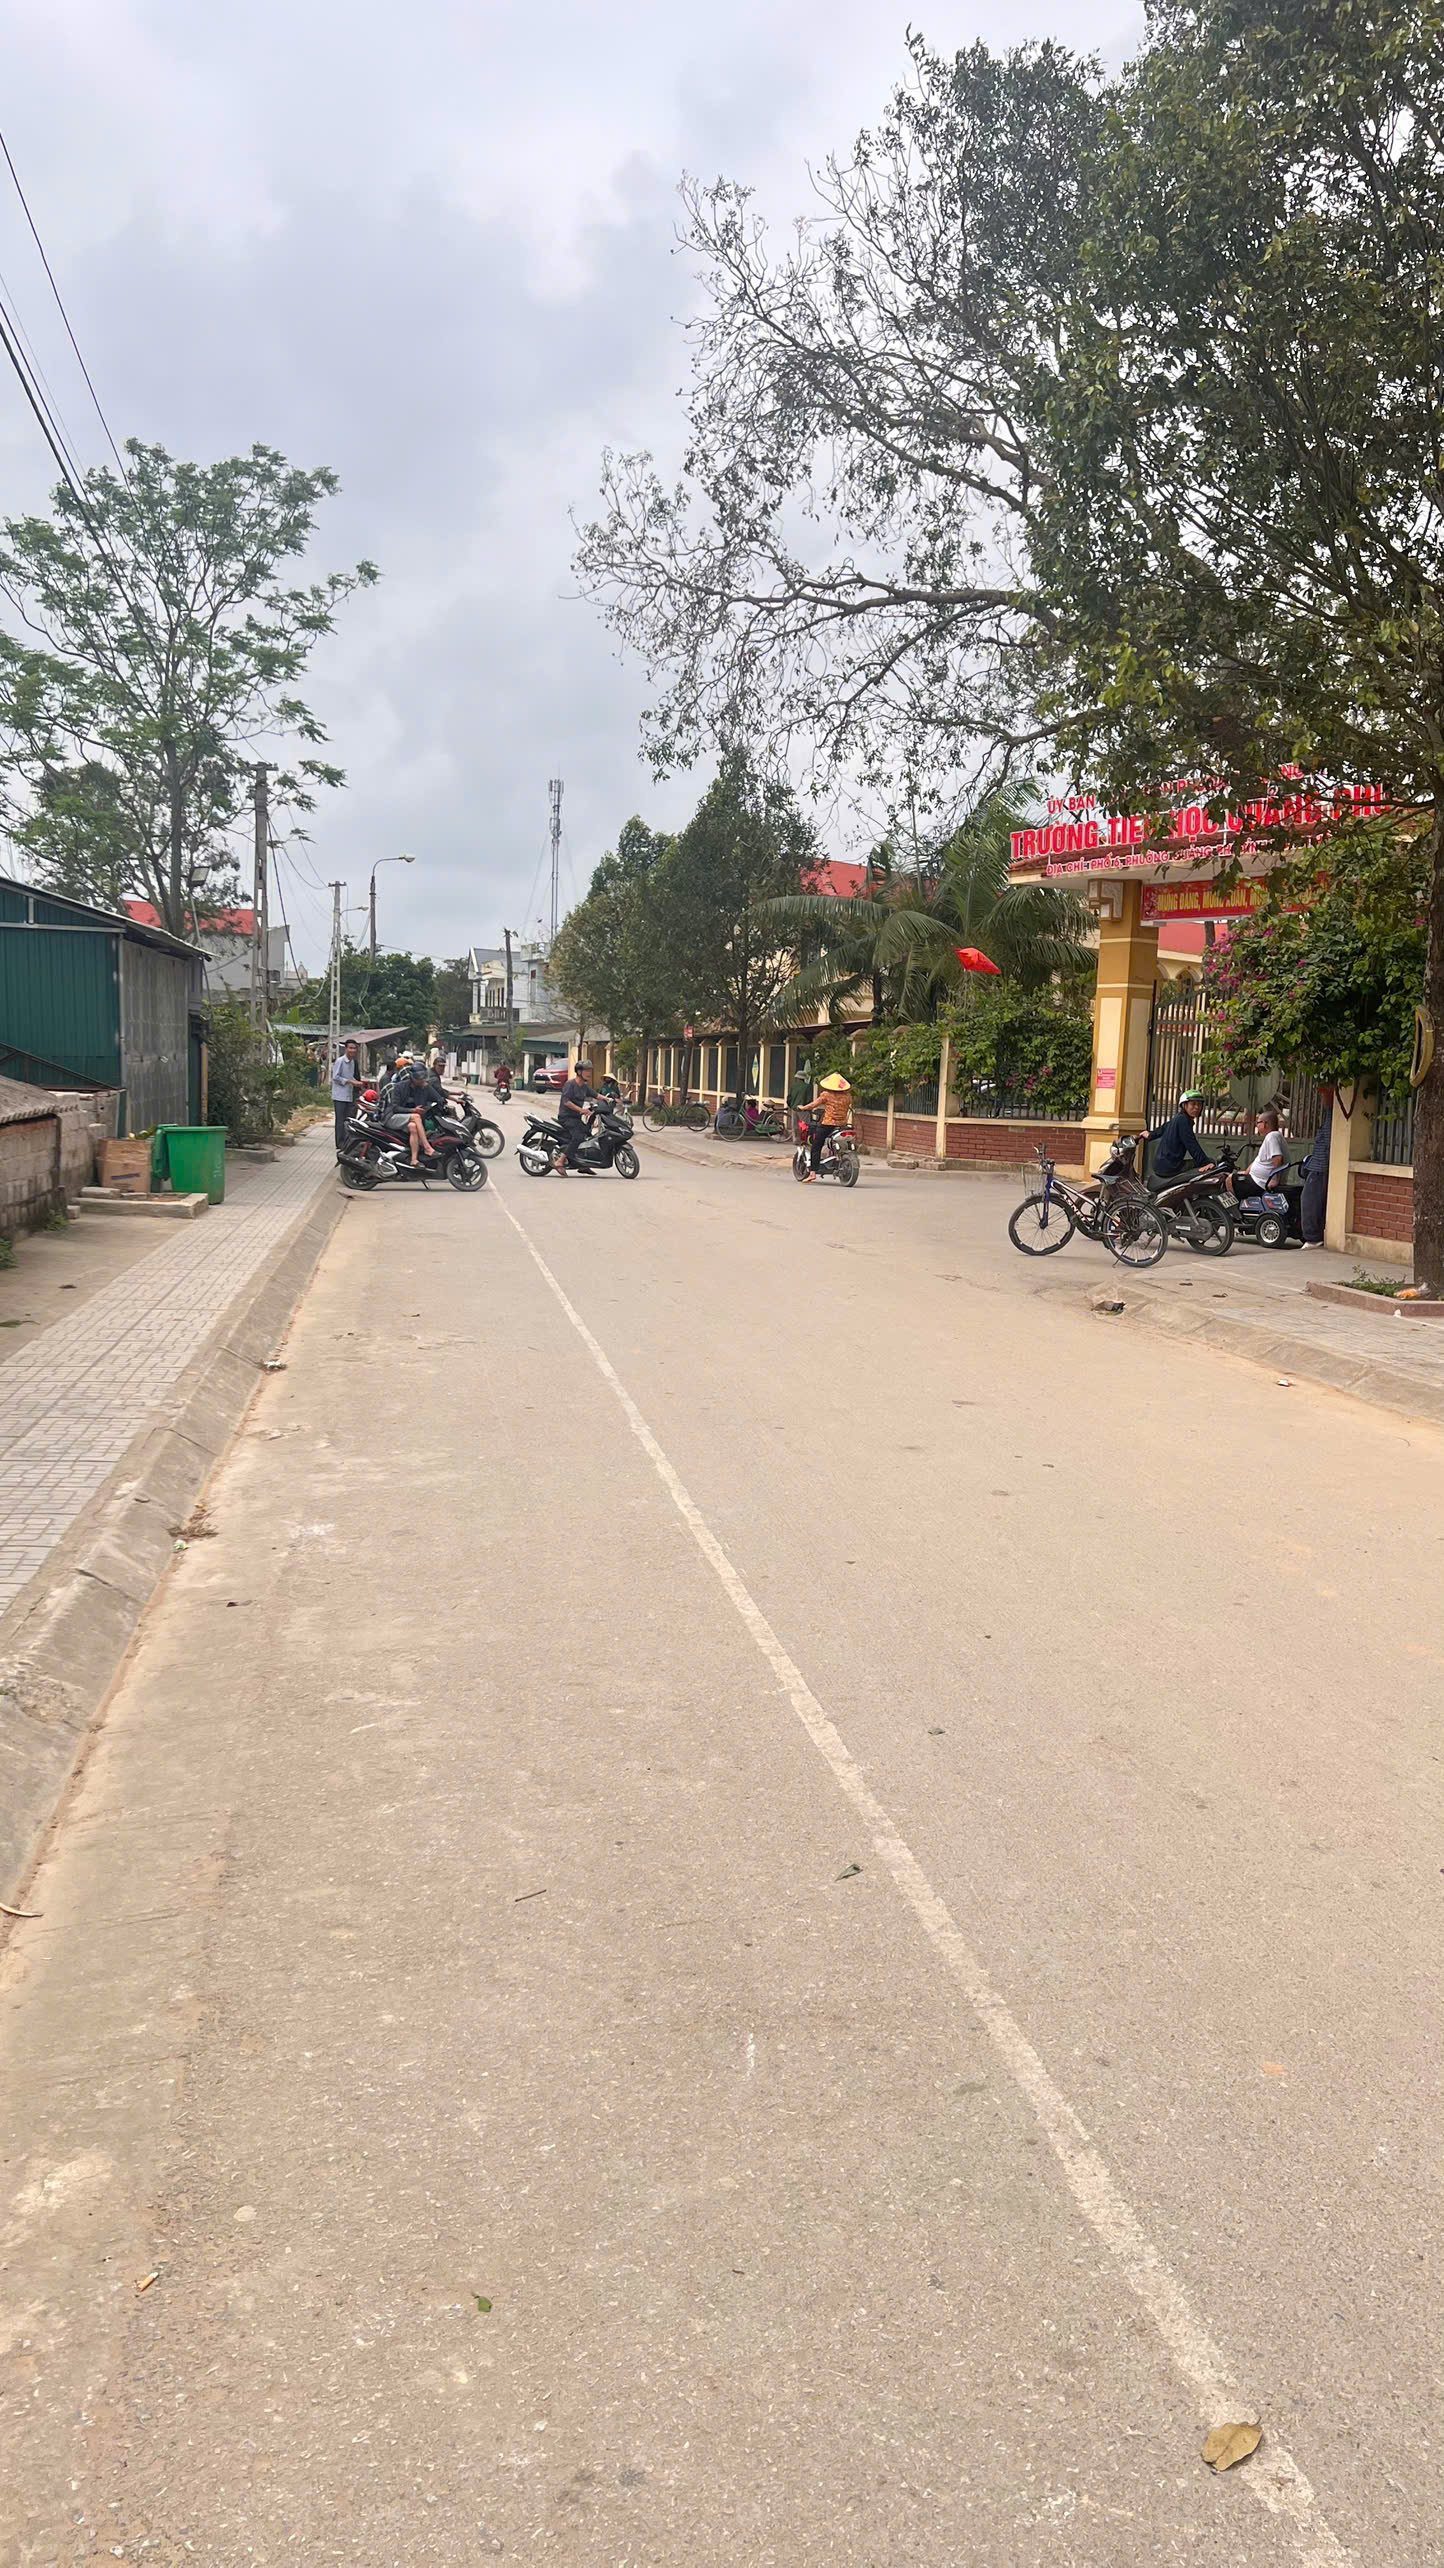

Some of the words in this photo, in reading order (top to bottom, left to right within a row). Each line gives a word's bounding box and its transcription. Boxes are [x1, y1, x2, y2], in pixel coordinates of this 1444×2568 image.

[1047, 795, 1064, 814] ỦY
[1069, 791, 1097, 811] BAN
[1010, 820, 1099, 859] TRƯỜNG
[1091, 851, 1113, 871] PHỐ
[1125, 849, 1169, 866] PHƯỜNG
